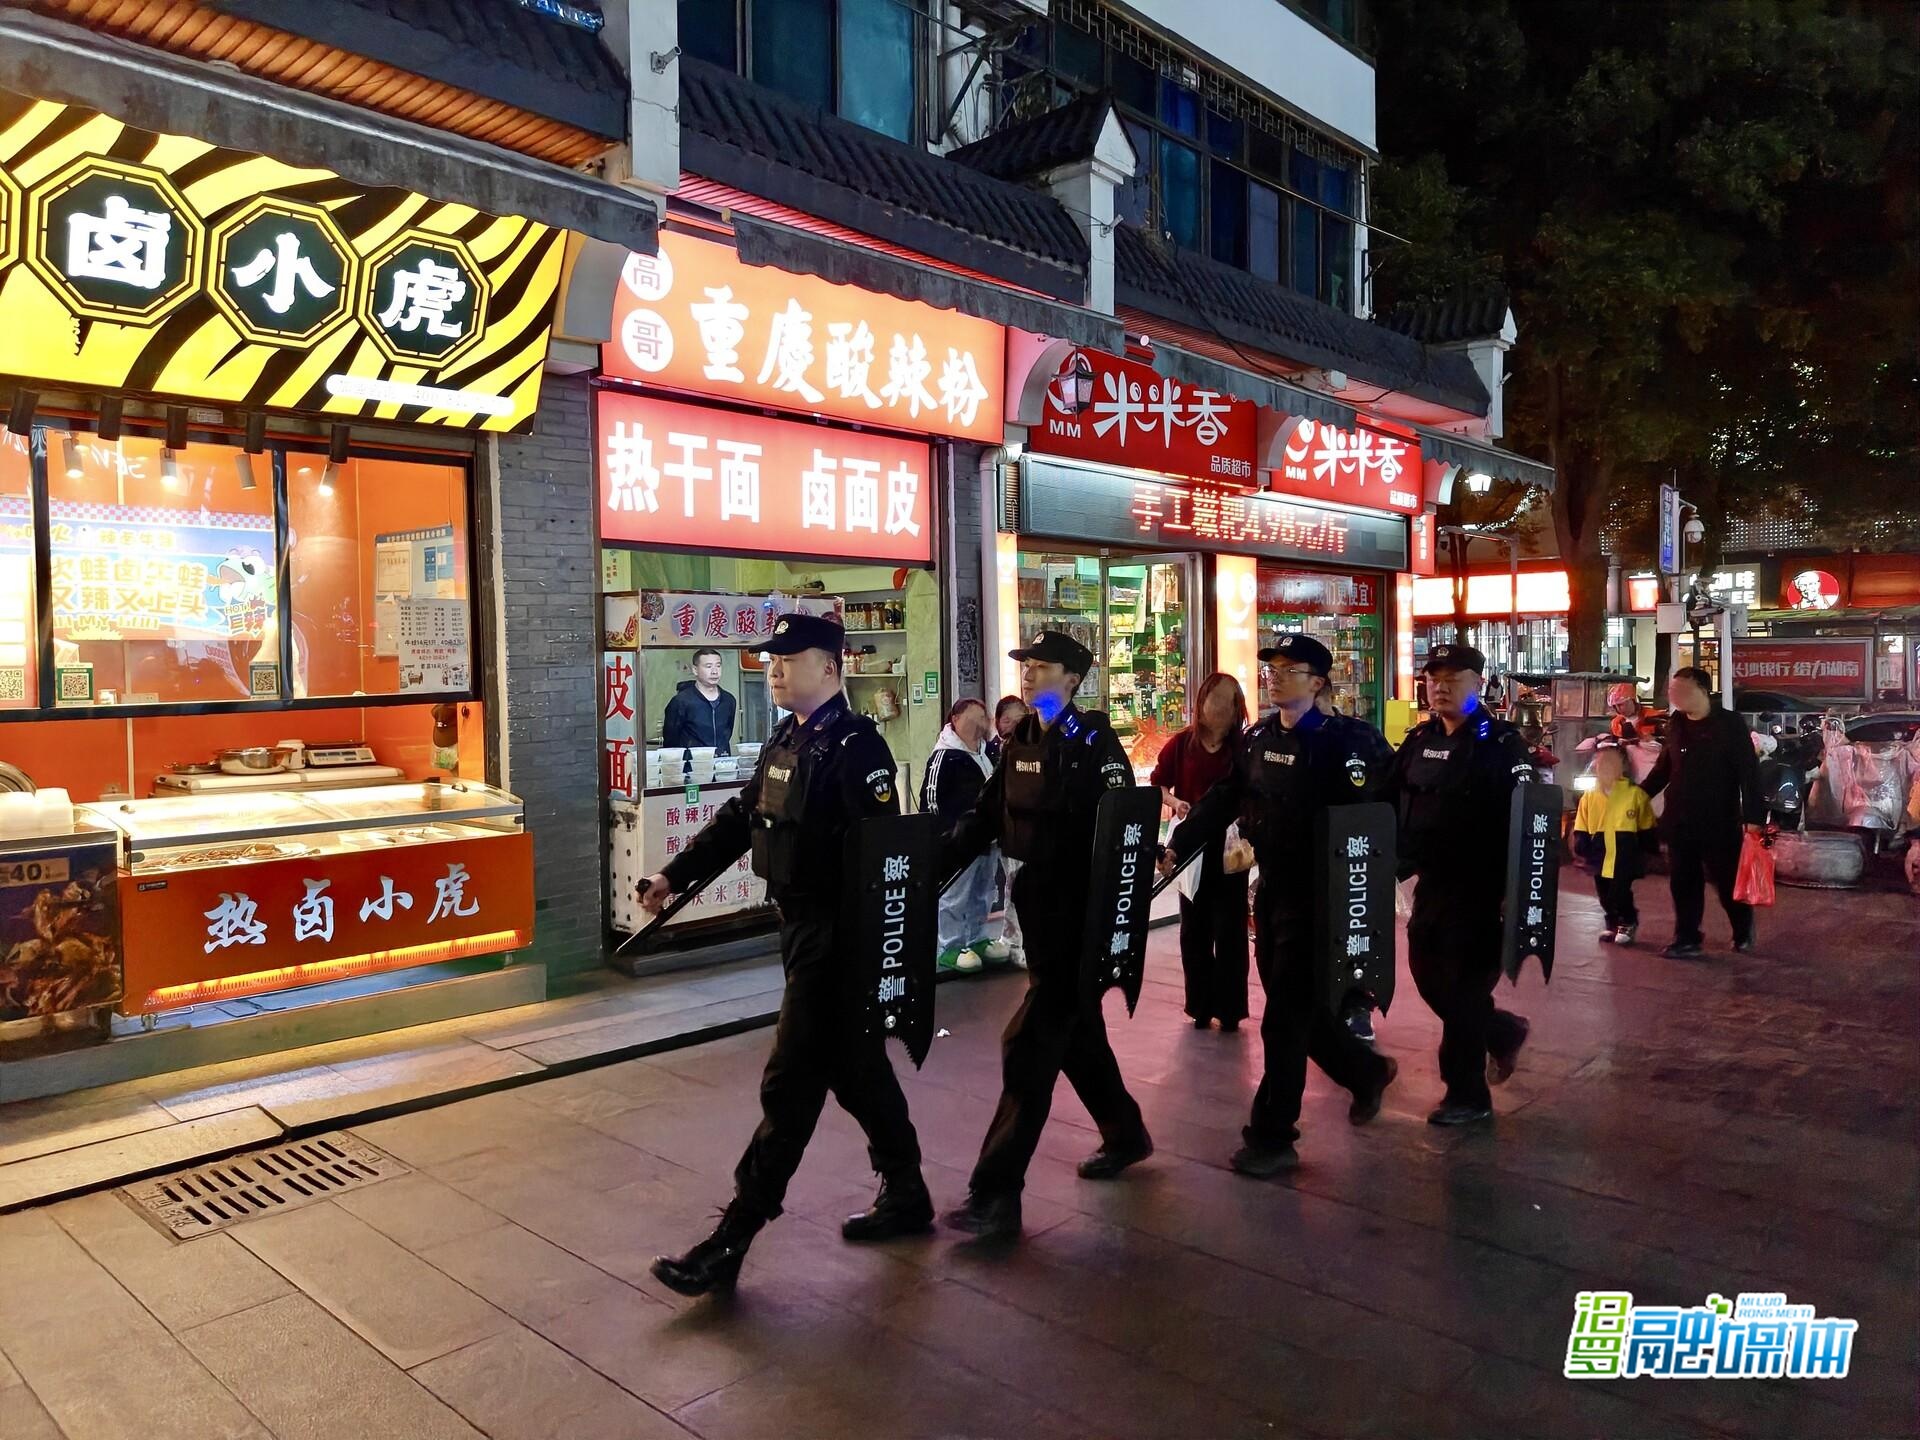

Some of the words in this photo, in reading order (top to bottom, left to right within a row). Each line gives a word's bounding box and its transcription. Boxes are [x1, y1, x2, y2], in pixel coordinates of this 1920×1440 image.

[67, 195, 468, 339] 卤小虎
[632, 252, 664, 362] 高哥
[690, 285, 989, 427] 重慶酸辣粉
[1050, 418, 1082, 439] MM
[1093, 371, 1231, 449] 米米香
[606, 421, 763, 524] 热干面
[801, 448, 921, 537] 卤面皮
[1210, 454, 1252, 479] 品质超市
[1285, 465, 1307, 481] MM
[1313, 424, 1406, 487] 米米香
[1123, 823, 1142, 847] 察
[1346, 835, 1370, 857] 察
[883, 855, 910, 882] 察
[1116, 851, 1137, 925] POLICE
[1349, 862, 1367, 929] POLICE
[1530, 838, 1545, 901] POLICE
[203, 863, 481, 955] 热卤小虎
[882, 887, 906, 969] POLICE
[1346, 934, 1370, 957] 警
[878, 975, 906, 1003] 警
